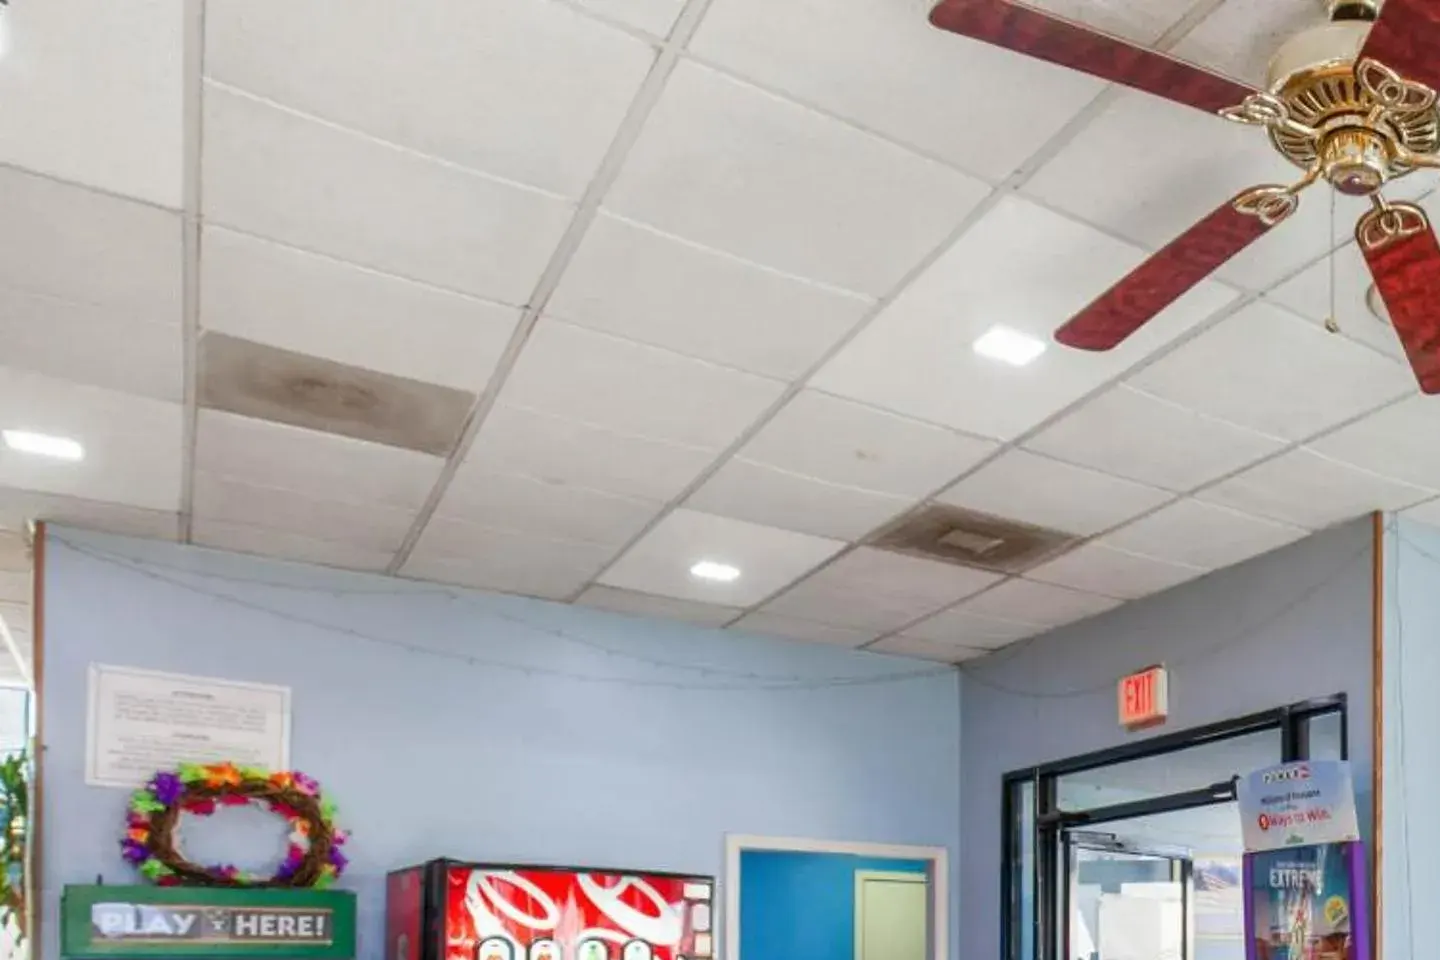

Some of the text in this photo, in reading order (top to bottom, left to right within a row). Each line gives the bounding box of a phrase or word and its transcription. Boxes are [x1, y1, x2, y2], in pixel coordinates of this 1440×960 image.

[1125, 674, 1153, 714] EXIT
[101, 913, 324, 936] PLAY HERE!
